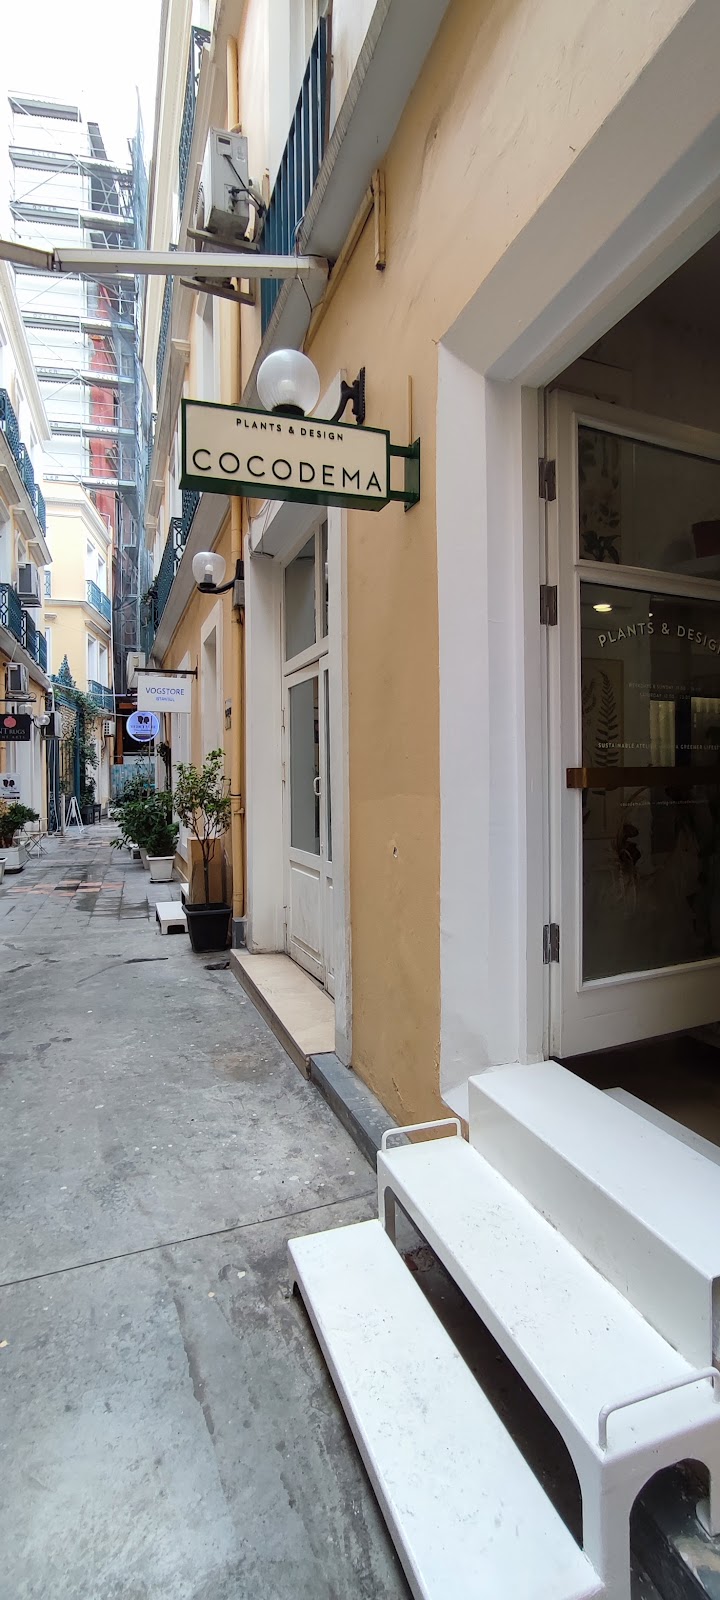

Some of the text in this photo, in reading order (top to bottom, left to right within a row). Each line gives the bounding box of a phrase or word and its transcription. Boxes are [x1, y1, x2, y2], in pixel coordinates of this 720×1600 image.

[236, 418, 343, 441] PLANTS & DESIGN
[192, 448, 382, 492] COCODEMA
[598, 621, 720, 655] PLANTS & DESIG
[146, 687, 185, 696] VOGSTORE
